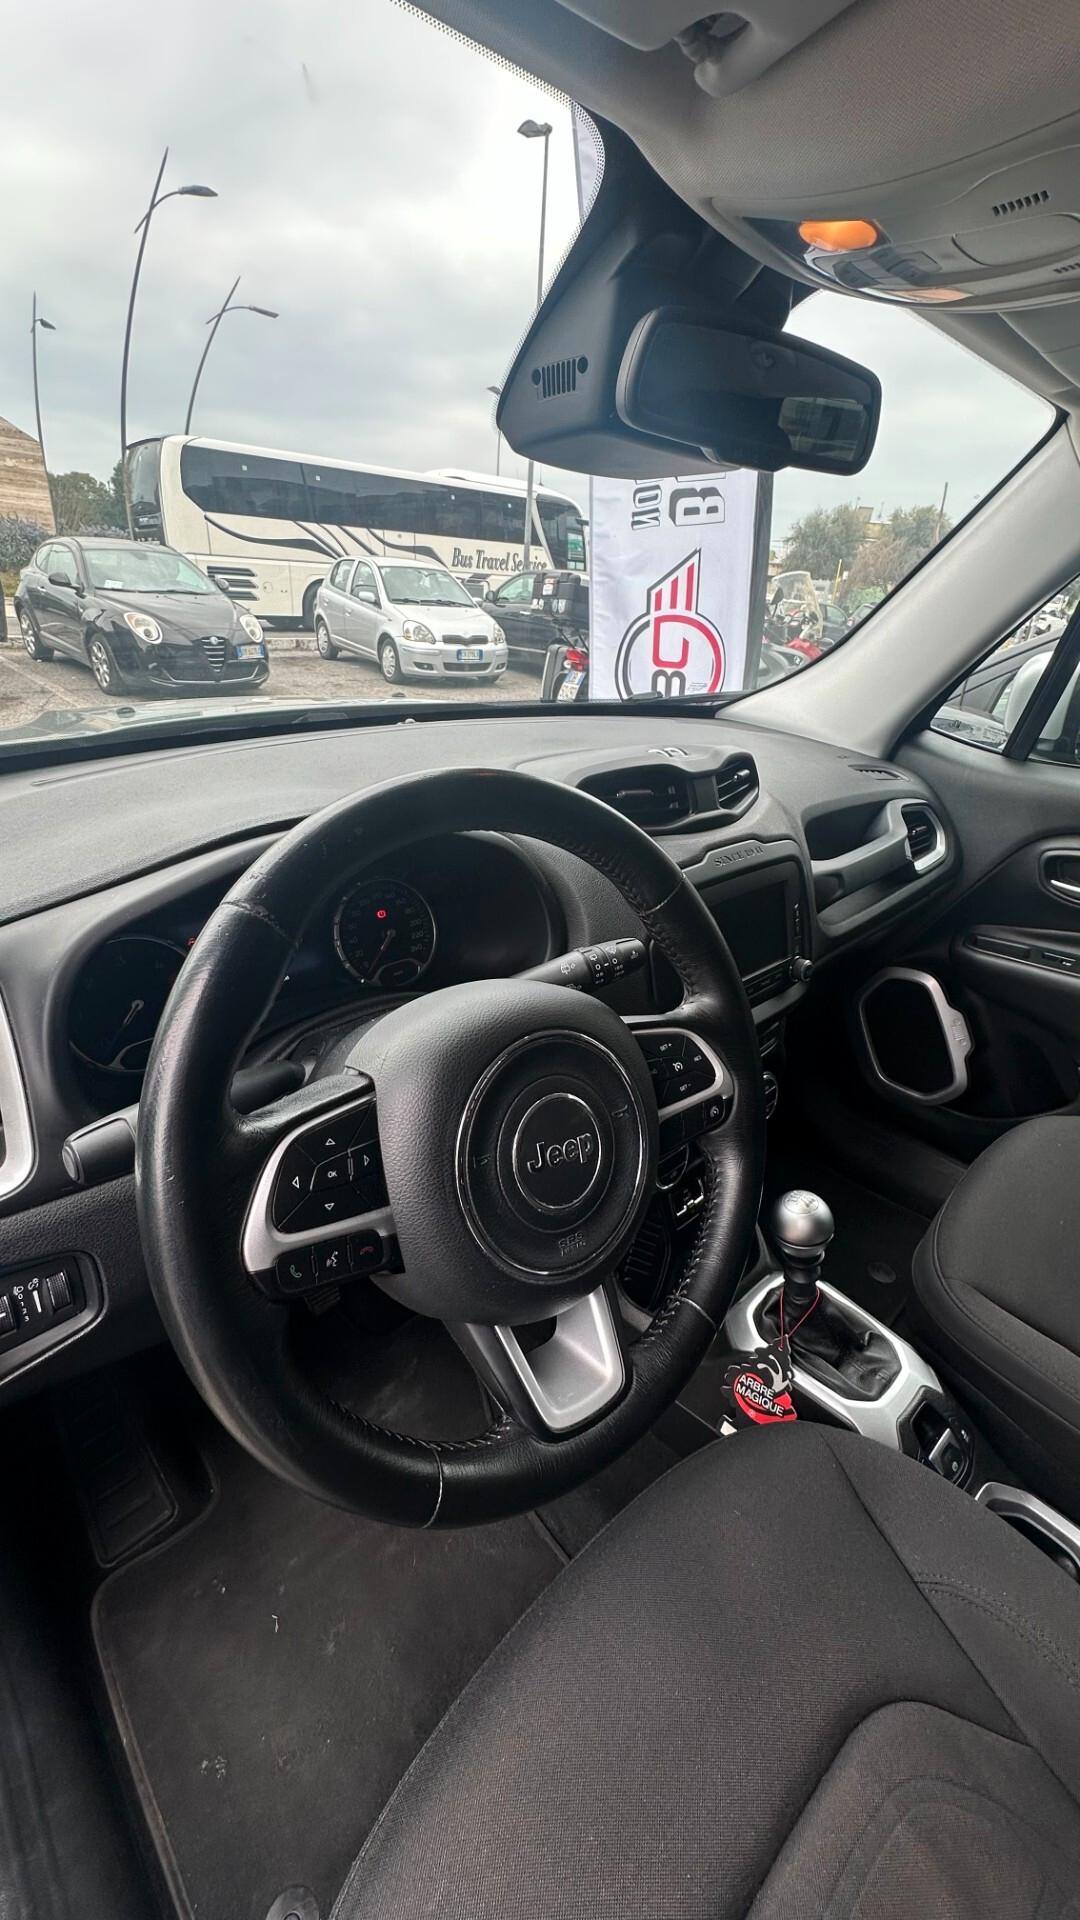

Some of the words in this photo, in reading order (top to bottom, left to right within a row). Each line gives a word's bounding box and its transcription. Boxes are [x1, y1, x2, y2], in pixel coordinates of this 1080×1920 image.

[452, 547, 474, 569] Bus
[476, 549, 511, 572] Travel
[527, 1133, 592, 1174] Jeep
[327, 1170, 338, 1178] OK
[736, 1383, 784, 1416] MAGIQUE
[739, 1374, 774, 1400] ARBRE
